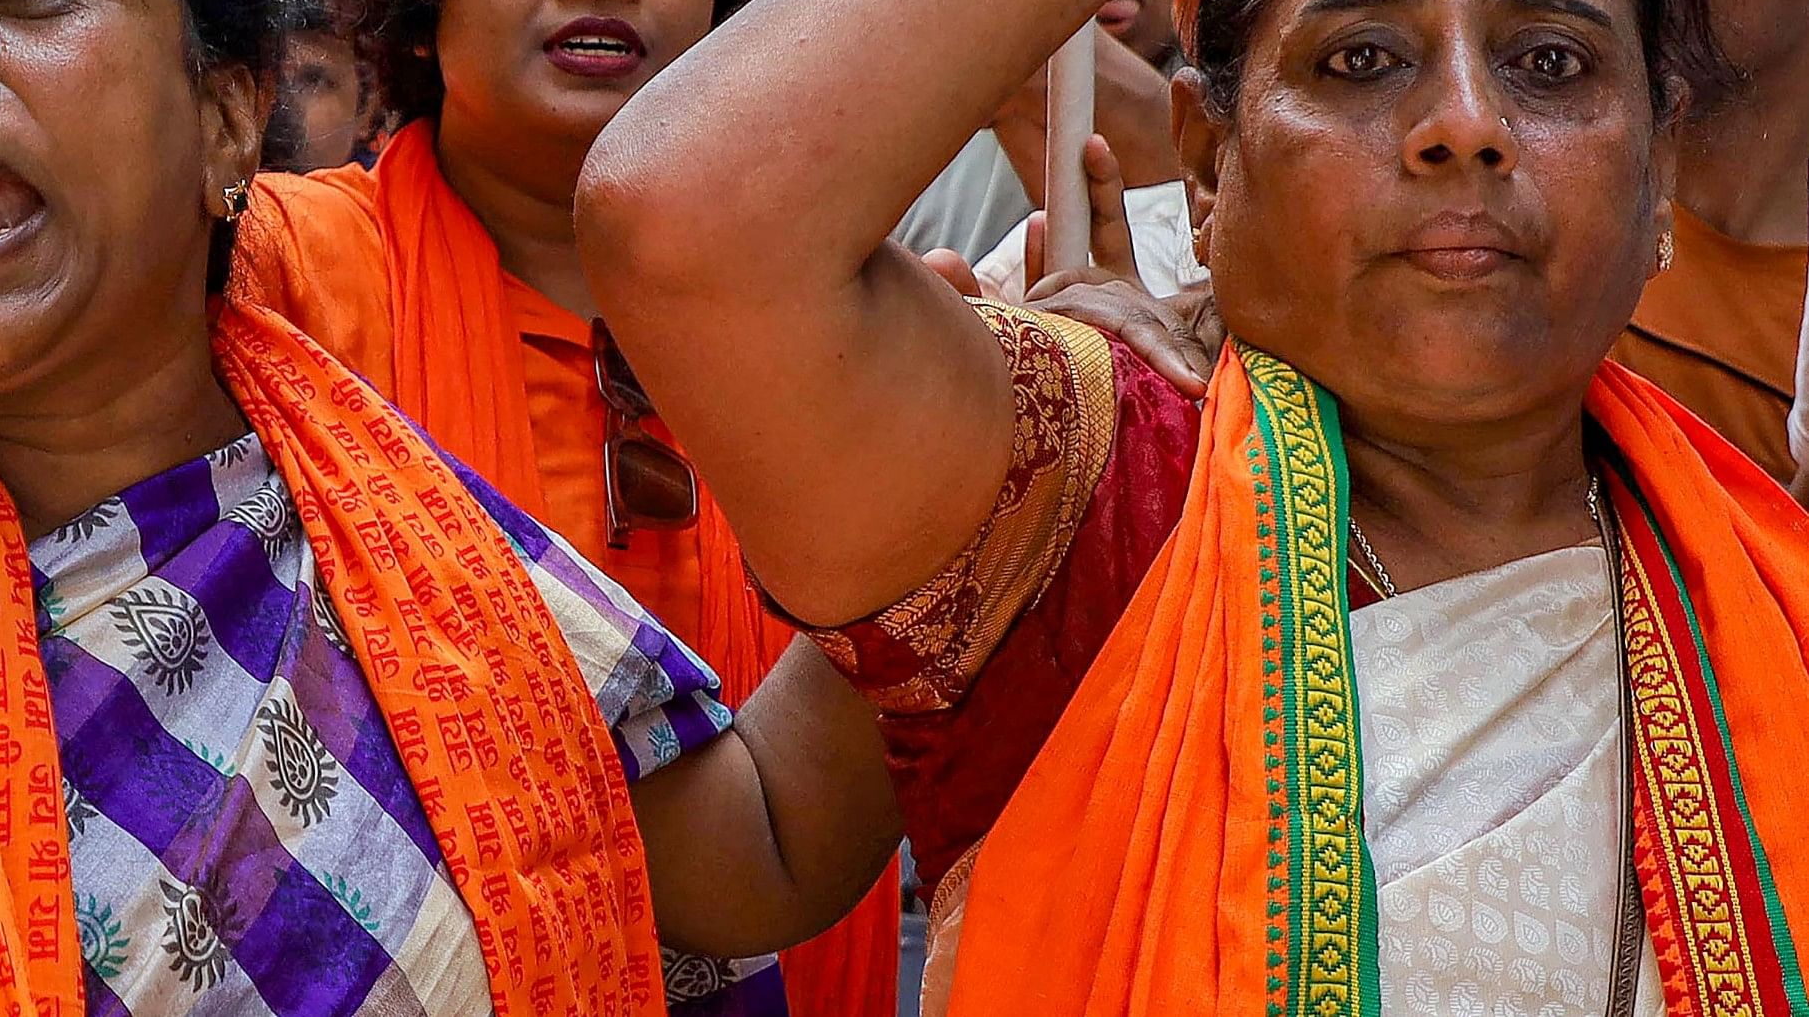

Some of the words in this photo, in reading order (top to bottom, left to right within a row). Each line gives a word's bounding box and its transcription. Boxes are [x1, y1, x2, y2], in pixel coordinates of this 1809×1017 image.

[330, 377, 369, 412] श्री
[323, 421, 369, 467] राम
[362, 414, 412, 470] जय
[325, 478, 367, 513] श्री
[367, 473, 402, 504] श्री
[414, 485, 461, 540] राम
[353, 518, 396, 572] जय
[399, 512, 444, 559] जय
[455, 544, 491, 580] श्री
[344, 580, 381, 617] श्री
[485, 588, 520, 642] जय
[362, 624, 400, 683] जय
[23, 670, 51, 734] राम
[389, 707, 429, 770] राम
[436, 713, 472, 775] जय
[460, 708, 499, 770] जय
[543, 737, 571, 777] श्री
[29, 765, 59, 829] जय
[561, 785, 588, 842] जय
[464, 801, 502, 864] राम
[497, 796, 533, 856] राम
[28, 840, 68, 884] श्री
[481, 871, 512, 916] श्री
[623, 867, 645, 927] जय
[28, 896, 59, 962] राम
[499, 926, 523, 989] जय
[626, 952, 650, 1007] राम
[529, 974, 555, 1015] श्री
